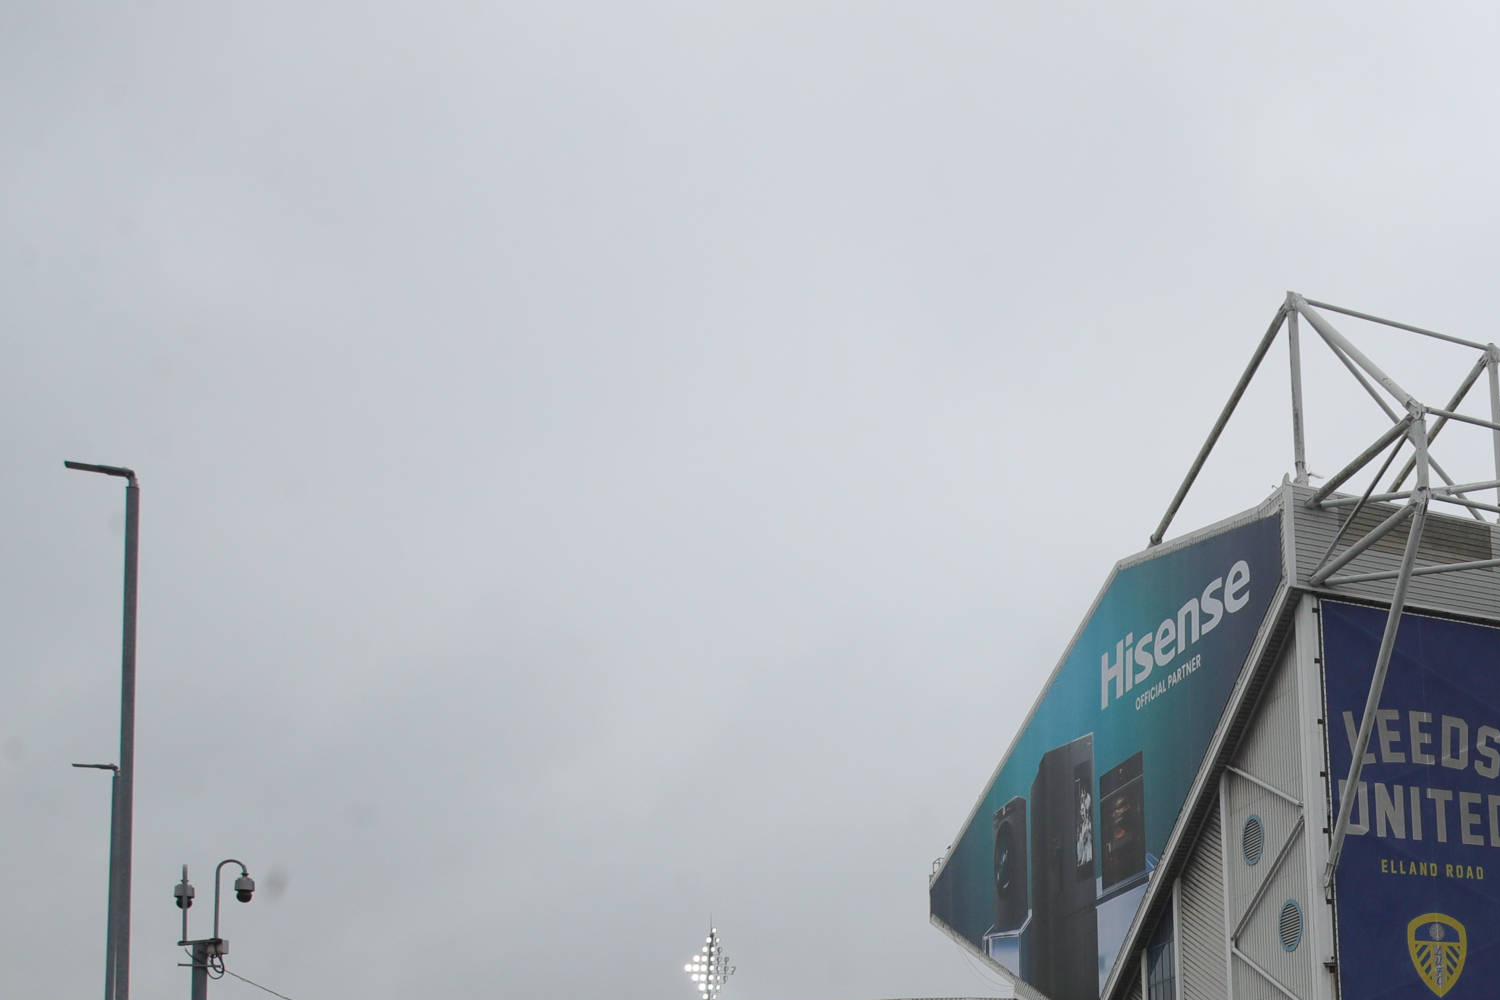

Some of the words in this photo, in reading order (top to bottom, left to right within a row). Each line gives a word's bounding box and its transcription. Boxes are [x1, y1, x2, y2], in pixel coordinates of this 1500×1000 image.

[1101, 560, 1250, 711] Hisense
[1136, 681, 1167, 711] OFFICIAL
[1168, 654, 1202, 690] PARTNER
[1381, 859, 1438, 877] ELLAND
[1446, 864, 1484, 880] ROAD
